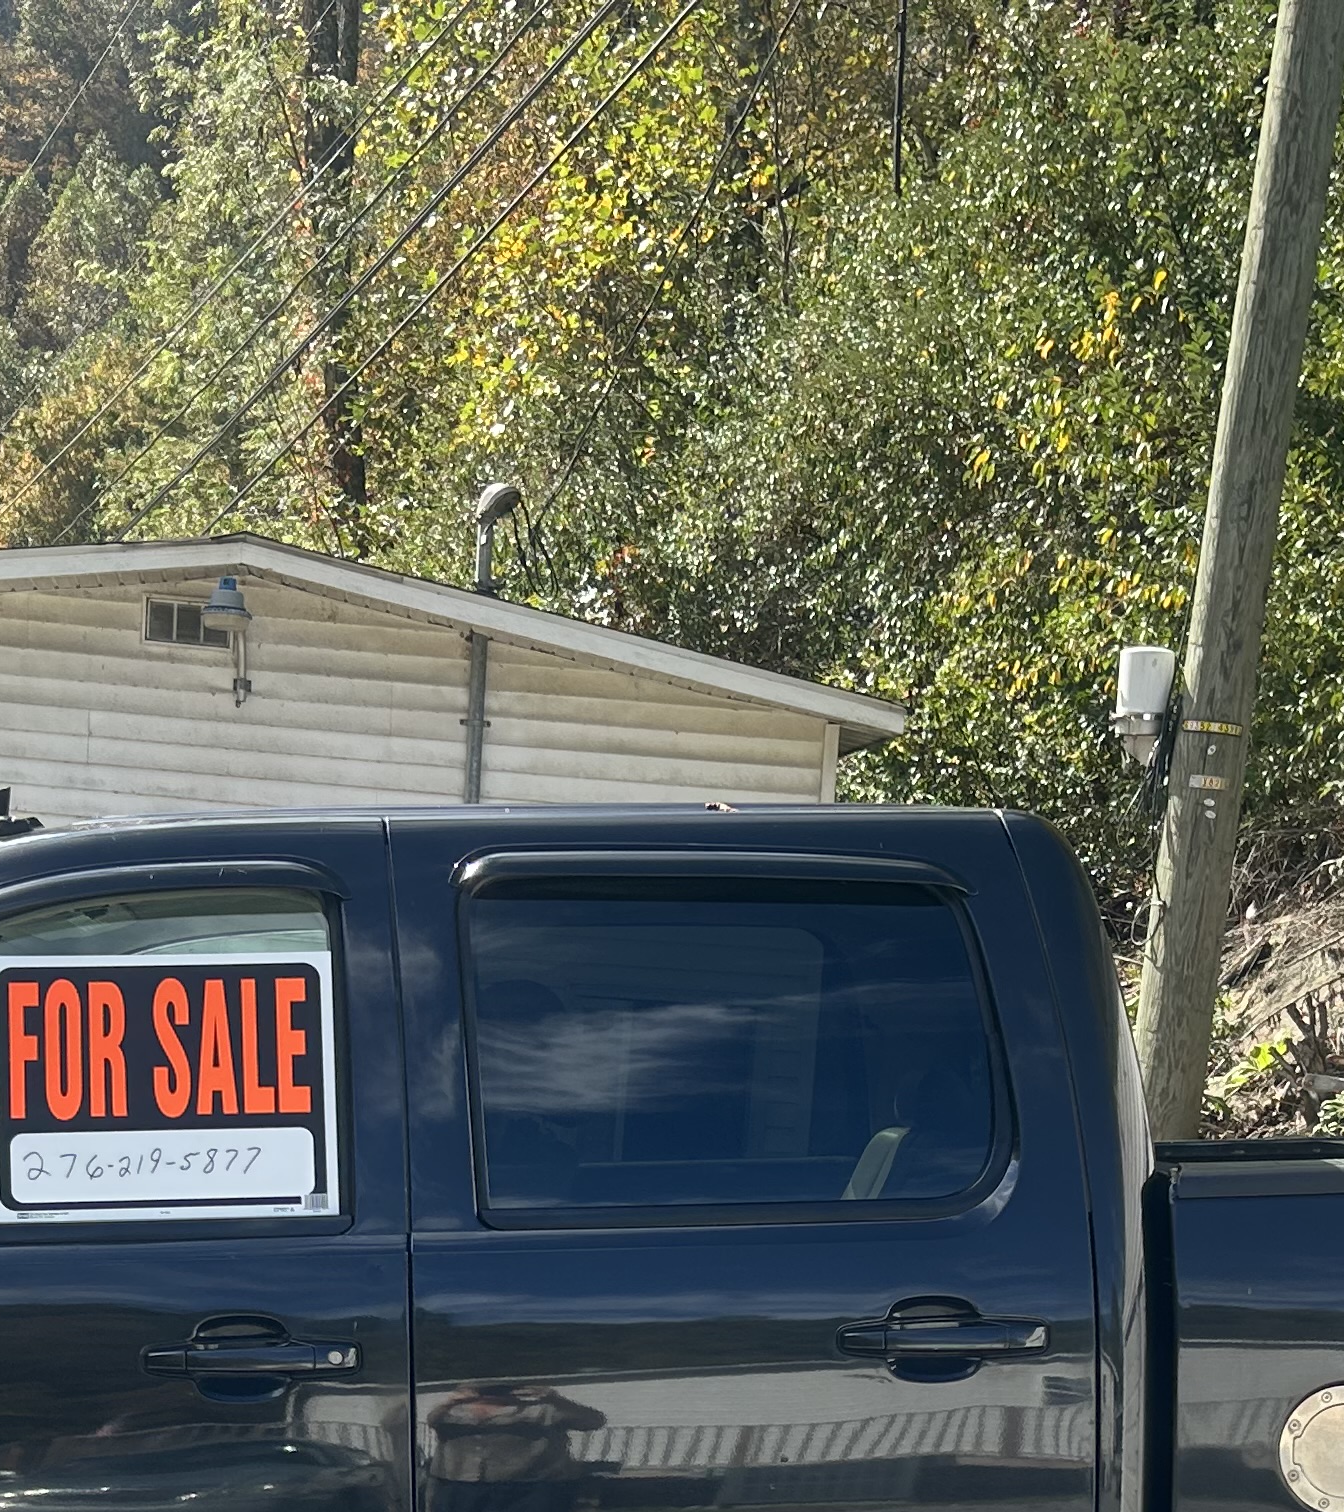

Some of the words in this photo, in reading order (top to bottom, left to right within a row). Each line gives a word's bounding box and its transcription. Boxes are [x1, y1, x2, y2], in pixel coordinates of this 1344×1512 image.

[8, 978, 128, 1120] FOR
[152, 977, 312, 1118] SALE
[22, 1147, 262, 1181] 276-219-5877
